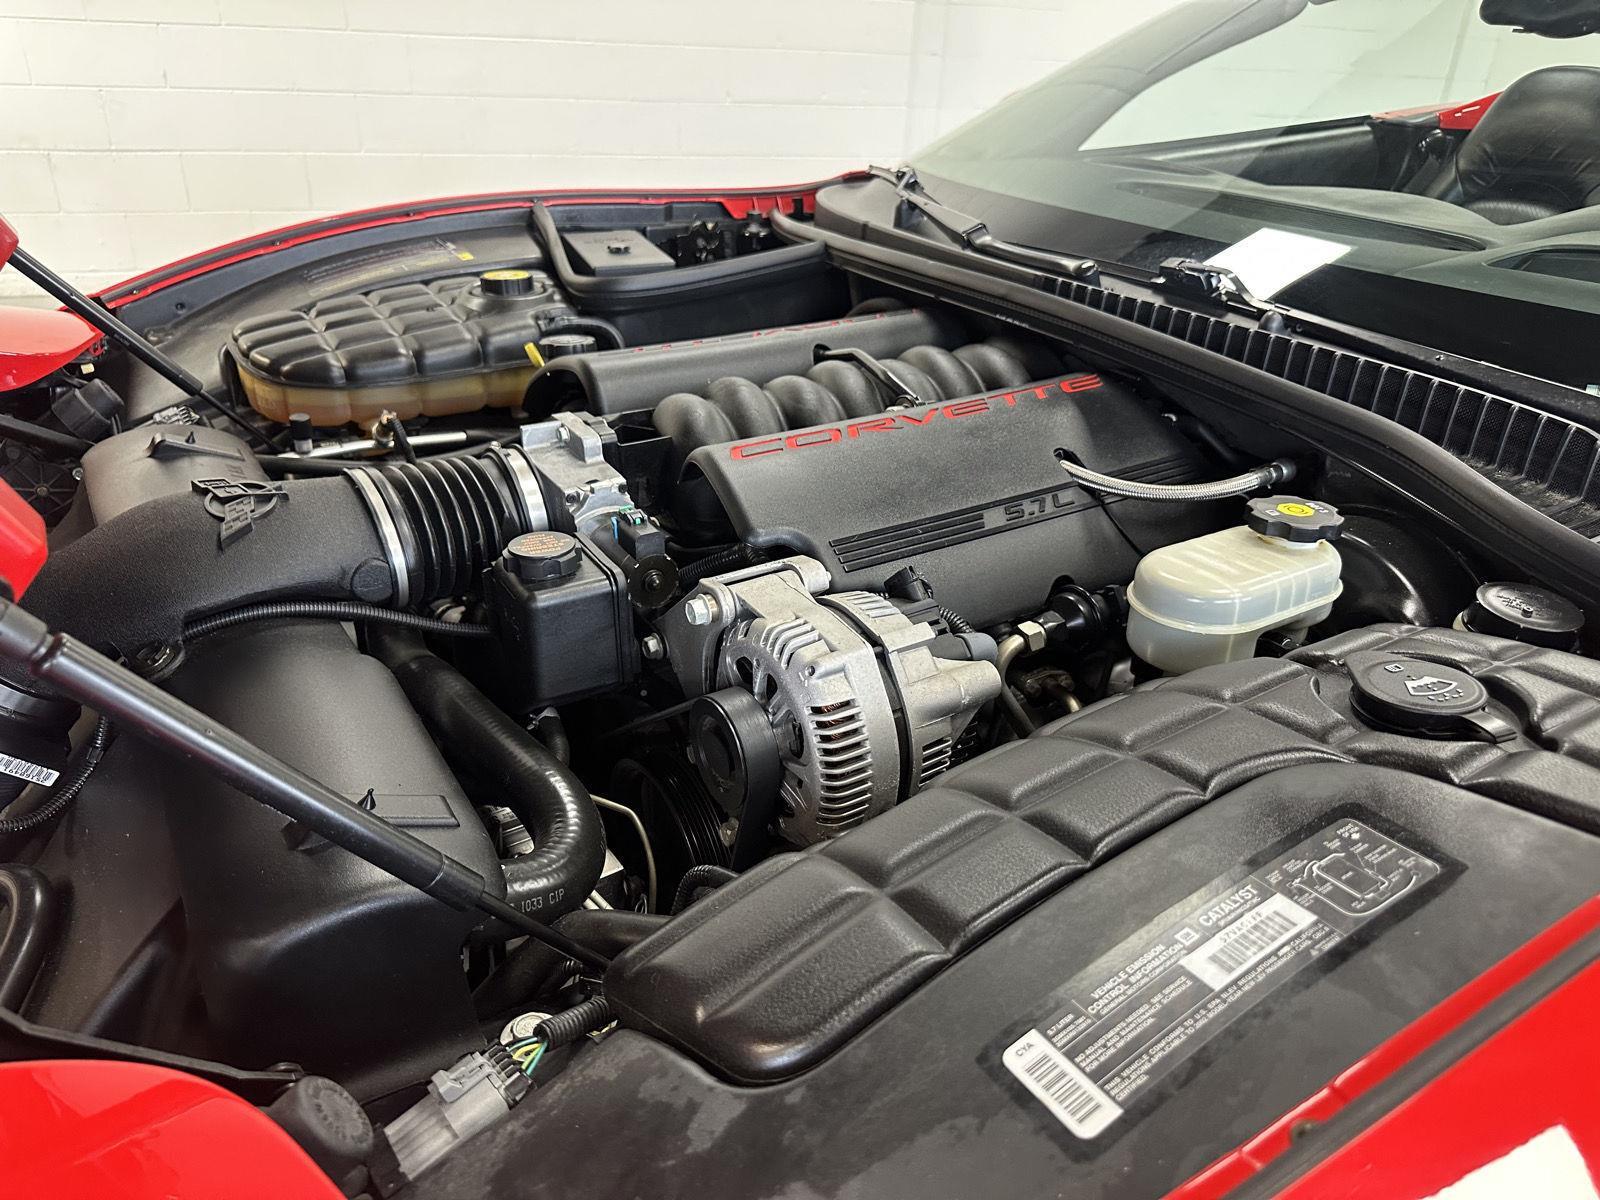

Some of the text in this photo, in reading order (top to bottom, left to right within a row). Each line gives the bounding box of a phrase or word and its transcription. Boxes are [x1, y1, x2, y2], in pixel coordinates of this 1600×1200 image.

[730, 374, 1103, 461] CORVETTE
[1004, 492, 1075, 522] 5.7L
[548, 888, 564, 904] CIP
[1197, 883, 1259, 927] CATALYST
[1086, 941, 1183, 1014] CONTROL INFORMATION
[1090, 943, 1166, 999] VEHICLE EMISSION
[1099, 992, 1127, 1014] GENERAL
[1125, 976, 1149, 994] MOTORS
[1055, 1013, 1074, 1028] LITER
[1074, 1052, 1086, 1063] NO
[1084, 1020, 1127, 1055] ADJUSTMENTS
[1149, 992, 1164, 1004] SEE
[1161, 974, 1187, 994] SERVICE
[1078, 979, 1193, 1067] MANUAL AND MAINTENANCE SCHEDULE
[1103, 1075, 1121, 1091] THIS
[1120, 1053, 1150, 1078] VEHICLE
[1148, 1025, 1185, 1055] CONFORMS
[1183, 1017, 1194, 1027] TO
[1193, 1007, 1207, 1019] U.S.
[1206, 997, 1220, 1008] EPA
[1236, 954, 1277, 985] REGULATIONS
[1109, 1060, 1152, 1096] REGULATIONS
[1149, 1032, 1187, 1063] APPLICABLE
[1184, 1025, 1195, 1035] TO
[1264, 948, 1297, 973] PASSENGER
[1014, 1040, 1034, 1057] CYA
[1083, 1058, 1099, 1072] FOR
[1097, 1045, 1116, 1062] MORE
